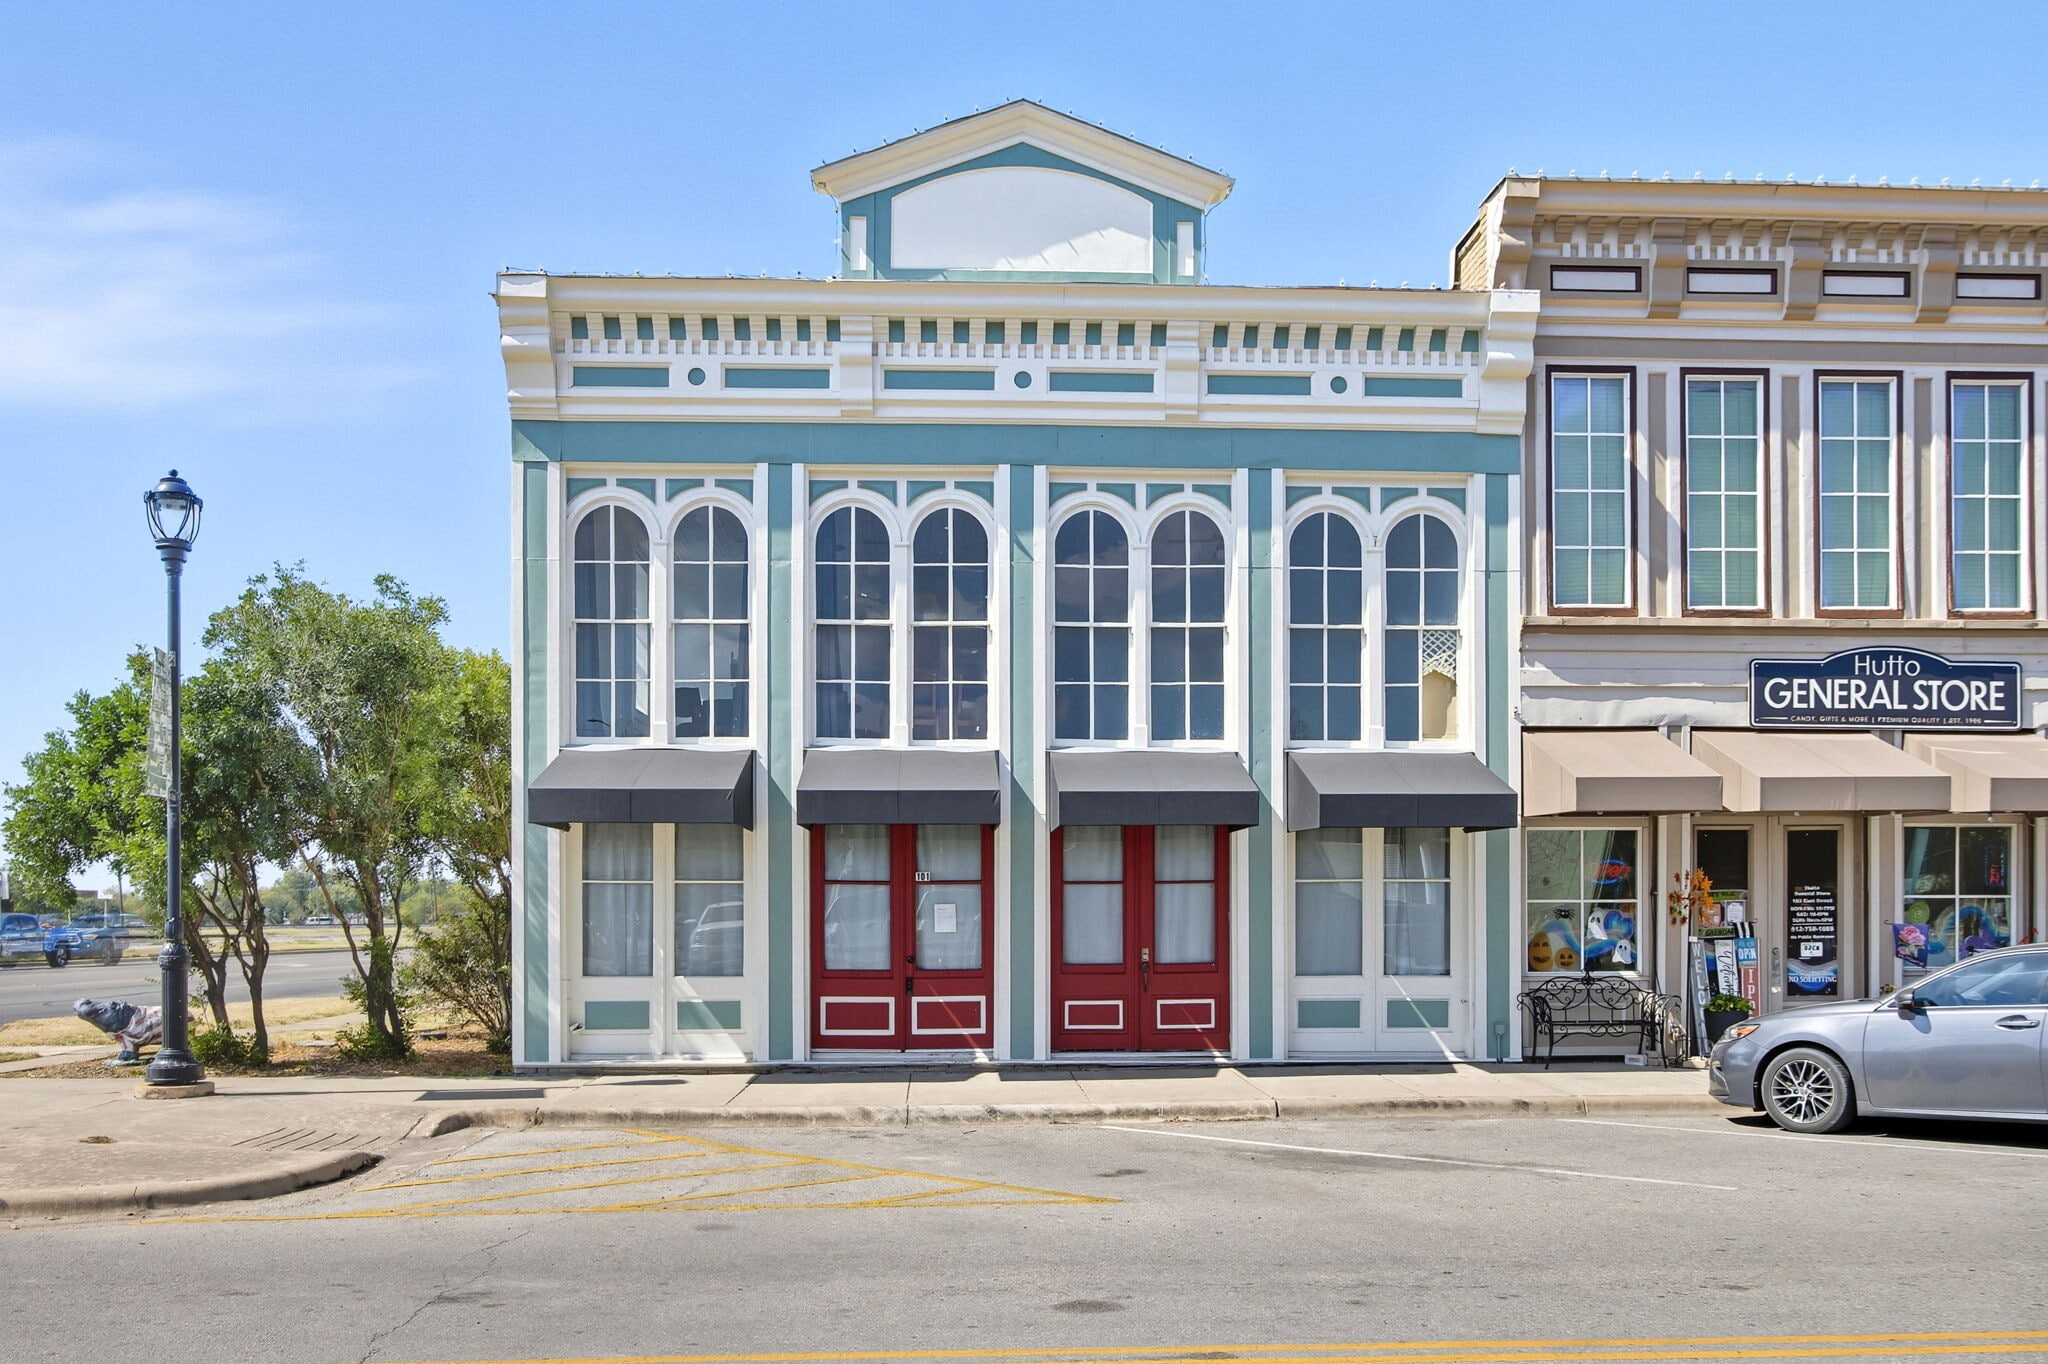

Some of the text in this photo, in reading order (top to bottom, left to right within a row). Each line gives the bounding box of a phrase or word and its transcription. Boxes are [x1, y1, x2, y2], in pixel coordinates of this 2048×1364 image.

[1854, 655, 1920, 676] Hutto
[1764, 677, 2005, 711] GENERAL STORE
[917, 872, 929, 881] 101
